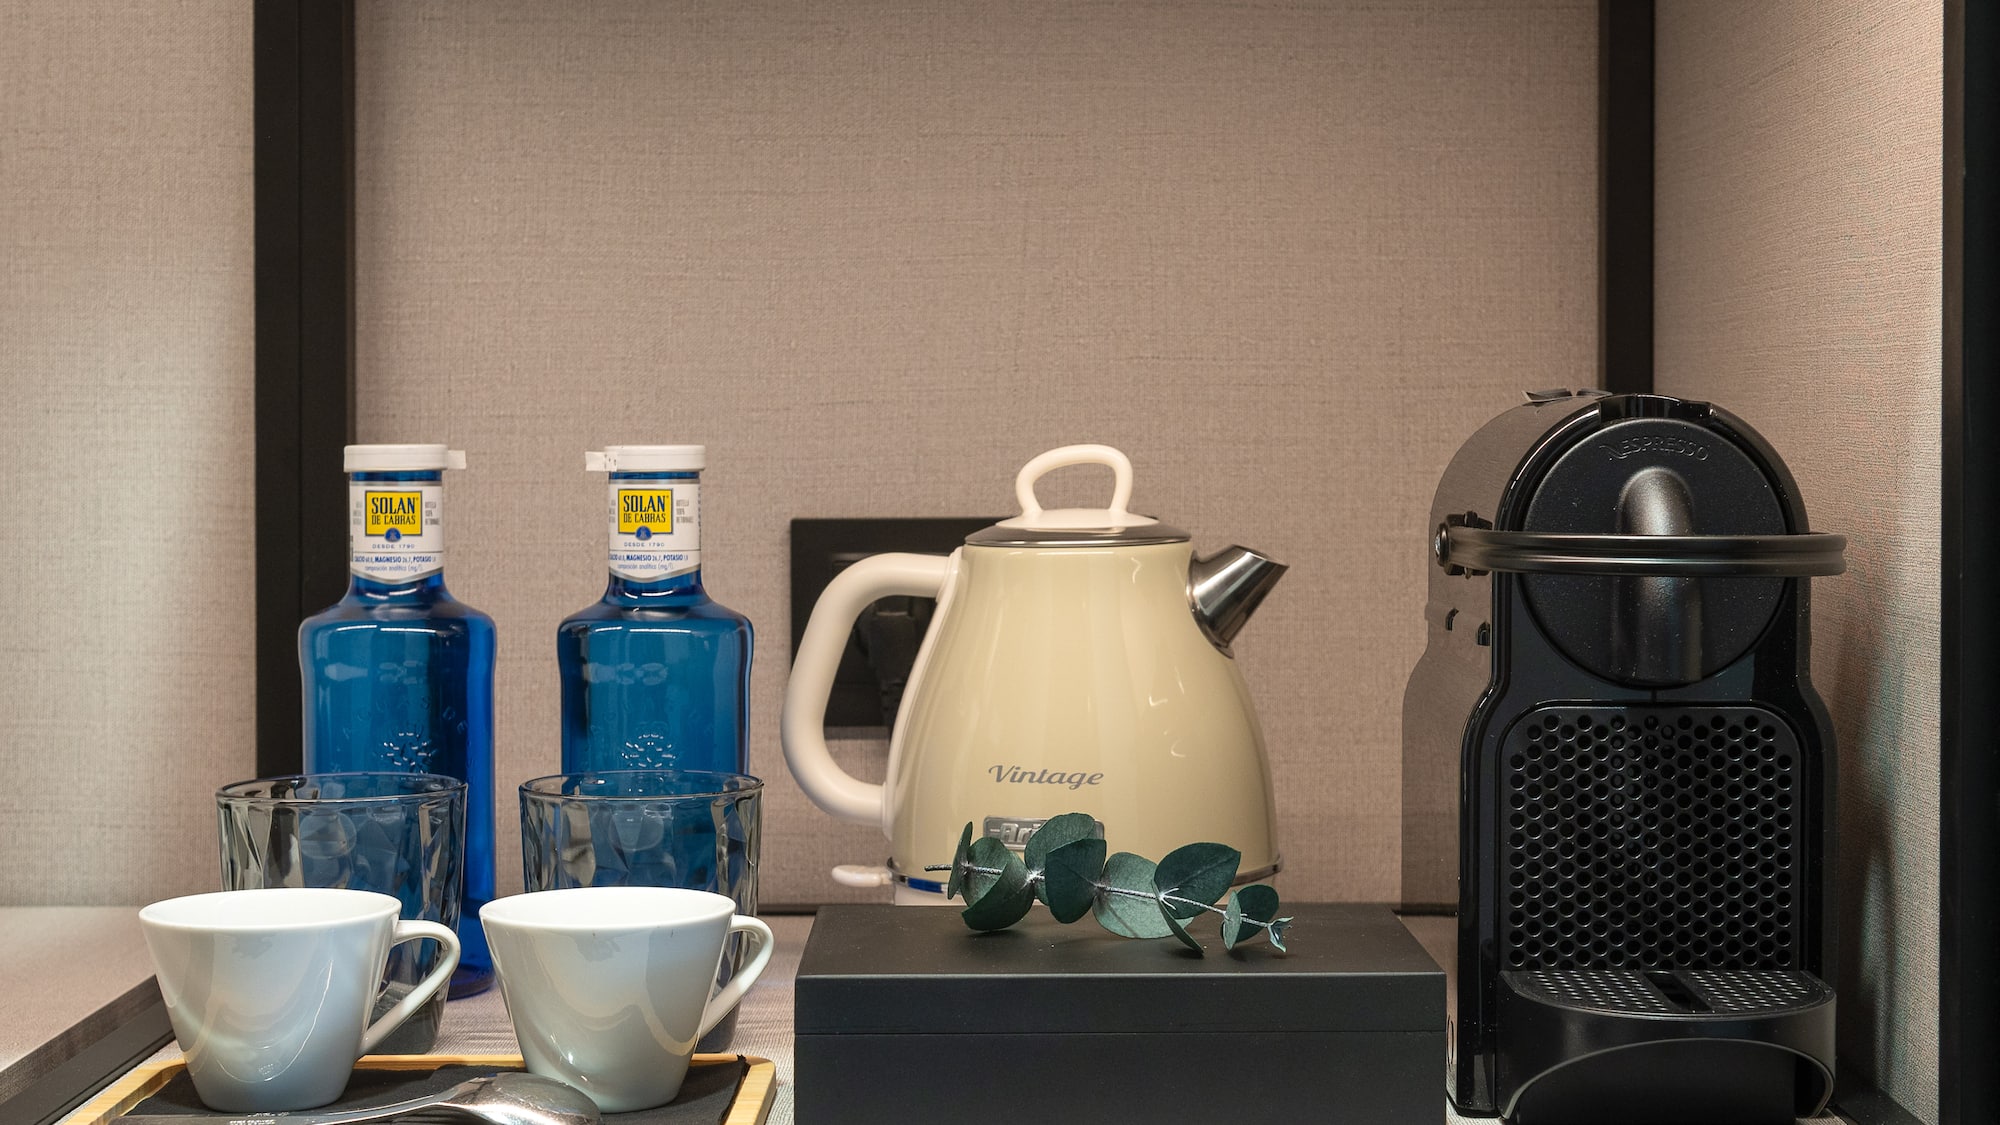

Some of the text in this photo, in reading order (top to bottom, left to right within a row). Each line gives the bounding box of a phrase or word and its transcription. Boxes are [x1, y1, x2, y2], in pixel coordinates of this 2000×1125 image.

[1598, 435, 1710, 461] NESPRESSO
[371, 497, 416, 514] SOLAN
[623, 495, 665, 512] SOLAN
[371, 514, 381, 525] DE
[384, 514, 416, 525] CABRAS
[623, 513, 666, 523] DE CABRAS
[988, 764, 1104, 790] Vintage
